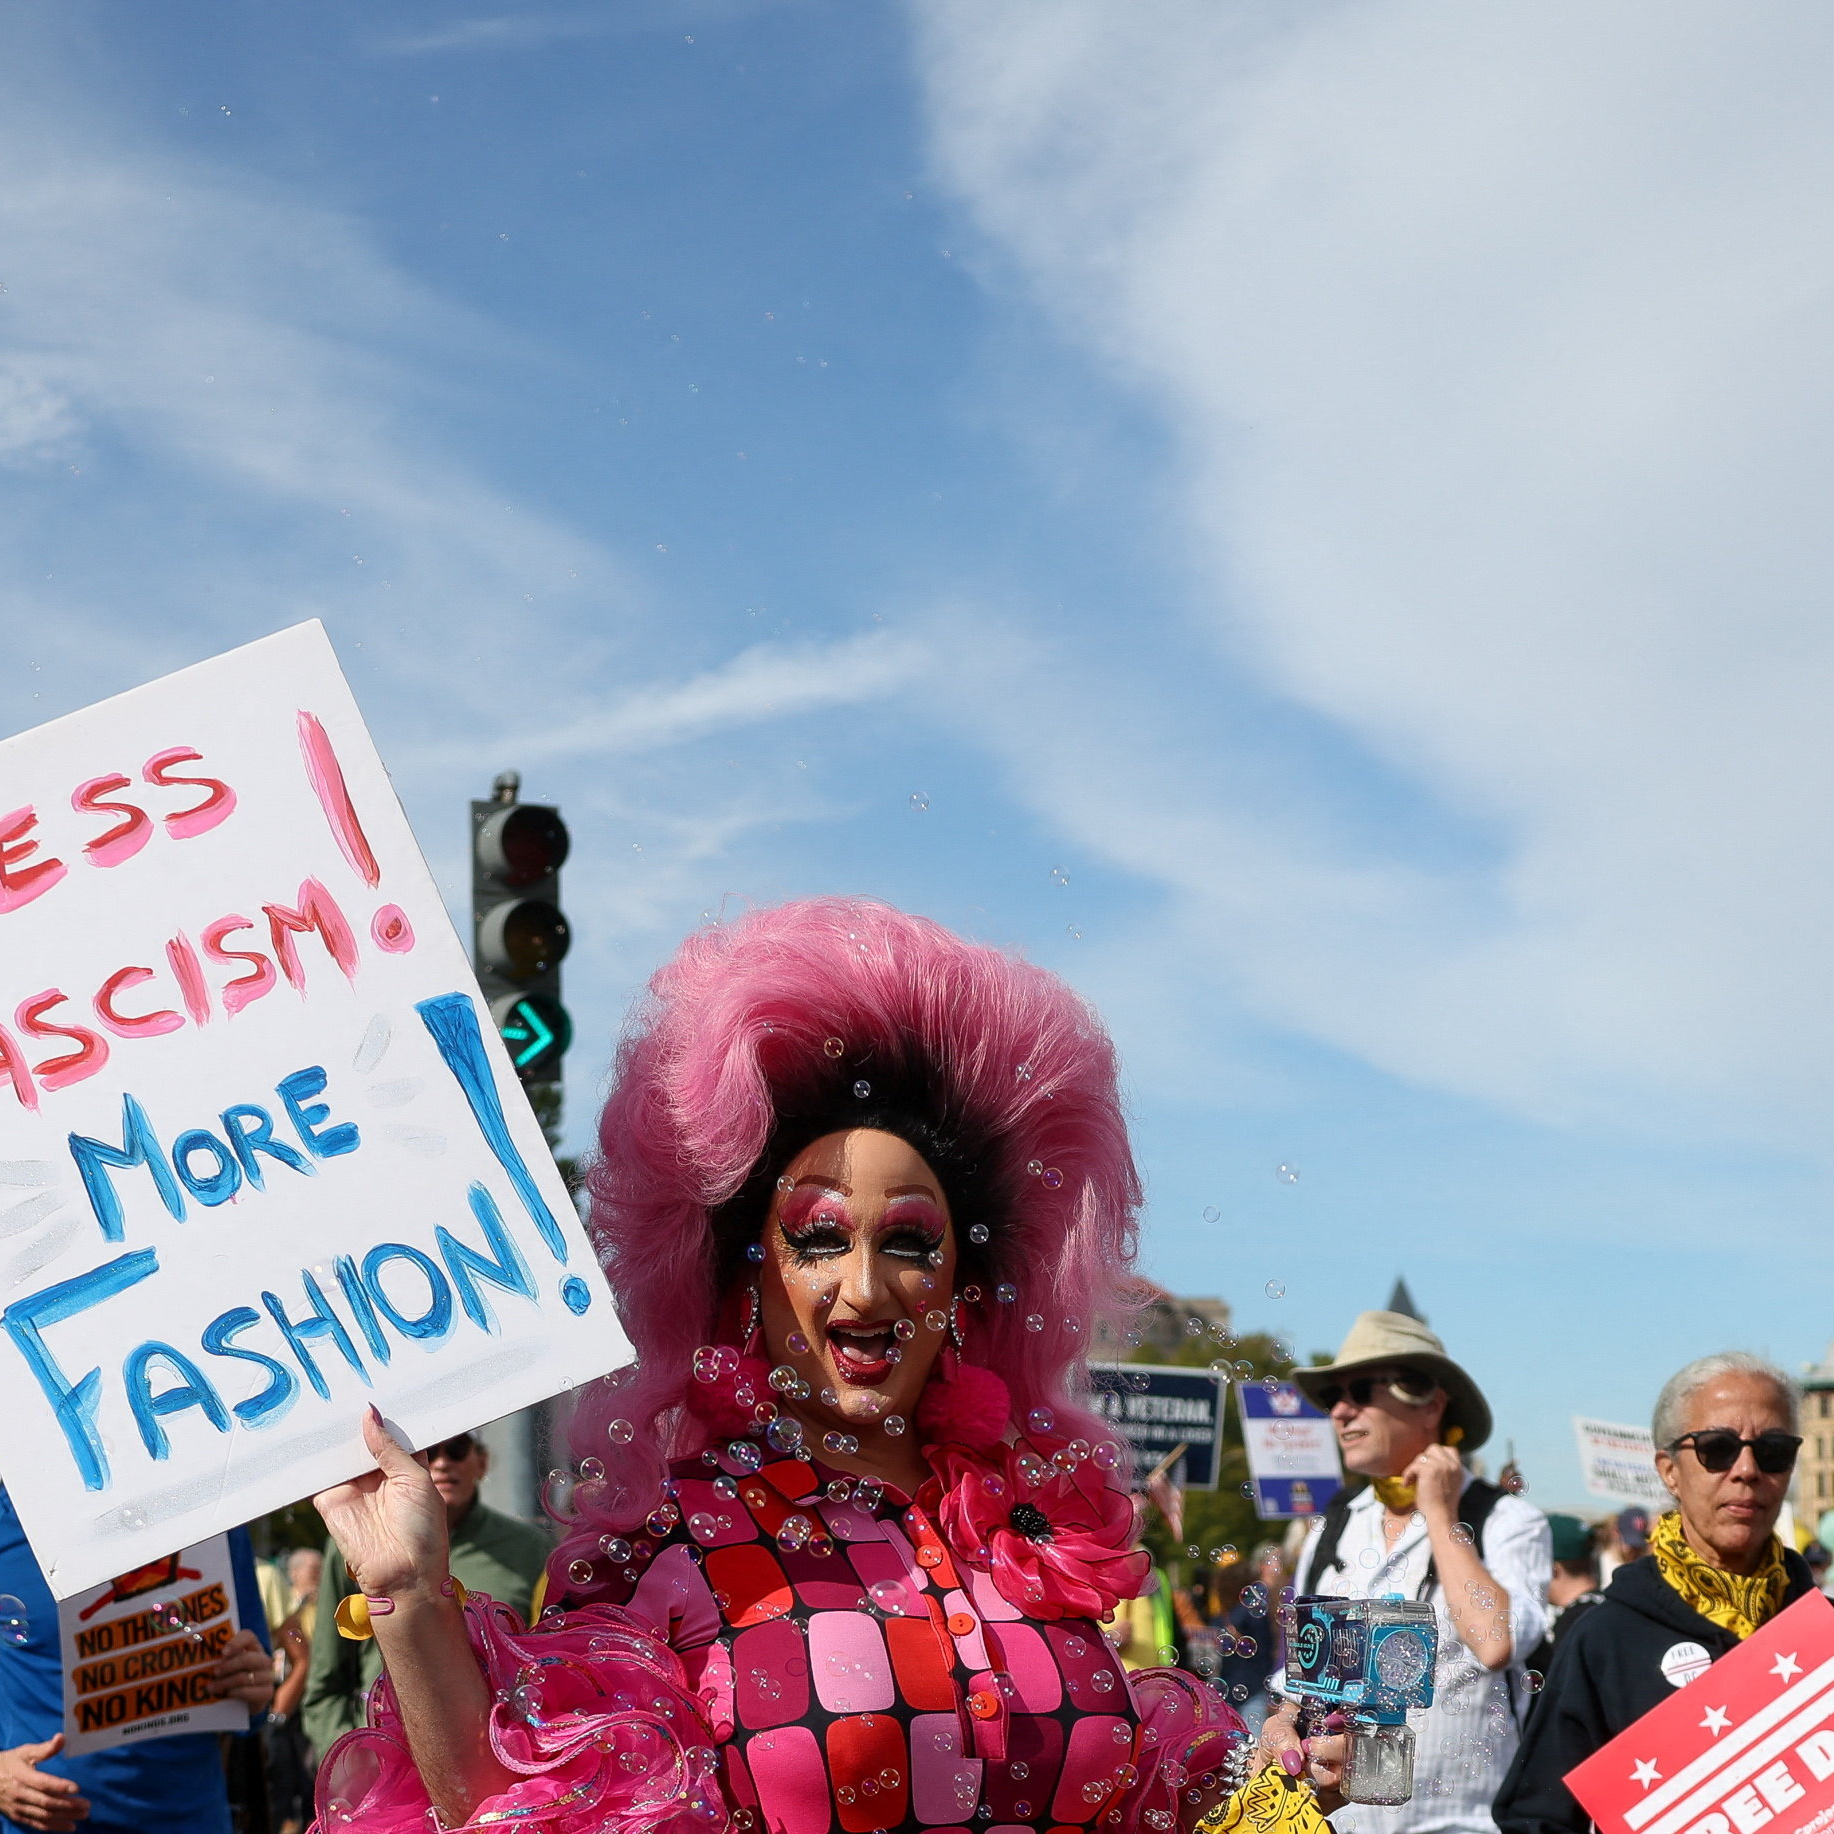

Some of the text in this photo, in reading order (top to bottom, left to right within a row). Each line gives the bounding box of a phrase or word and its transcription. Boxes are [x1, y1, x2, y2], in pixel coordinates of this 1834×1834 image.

[66, 1065, 361, 1243] MORE
[78, 1587, 225, 1659] NO THRONES
[80, 1628, 230, 1693] NO CROWNS
[82, 1672, 219, 1733] NO KING
